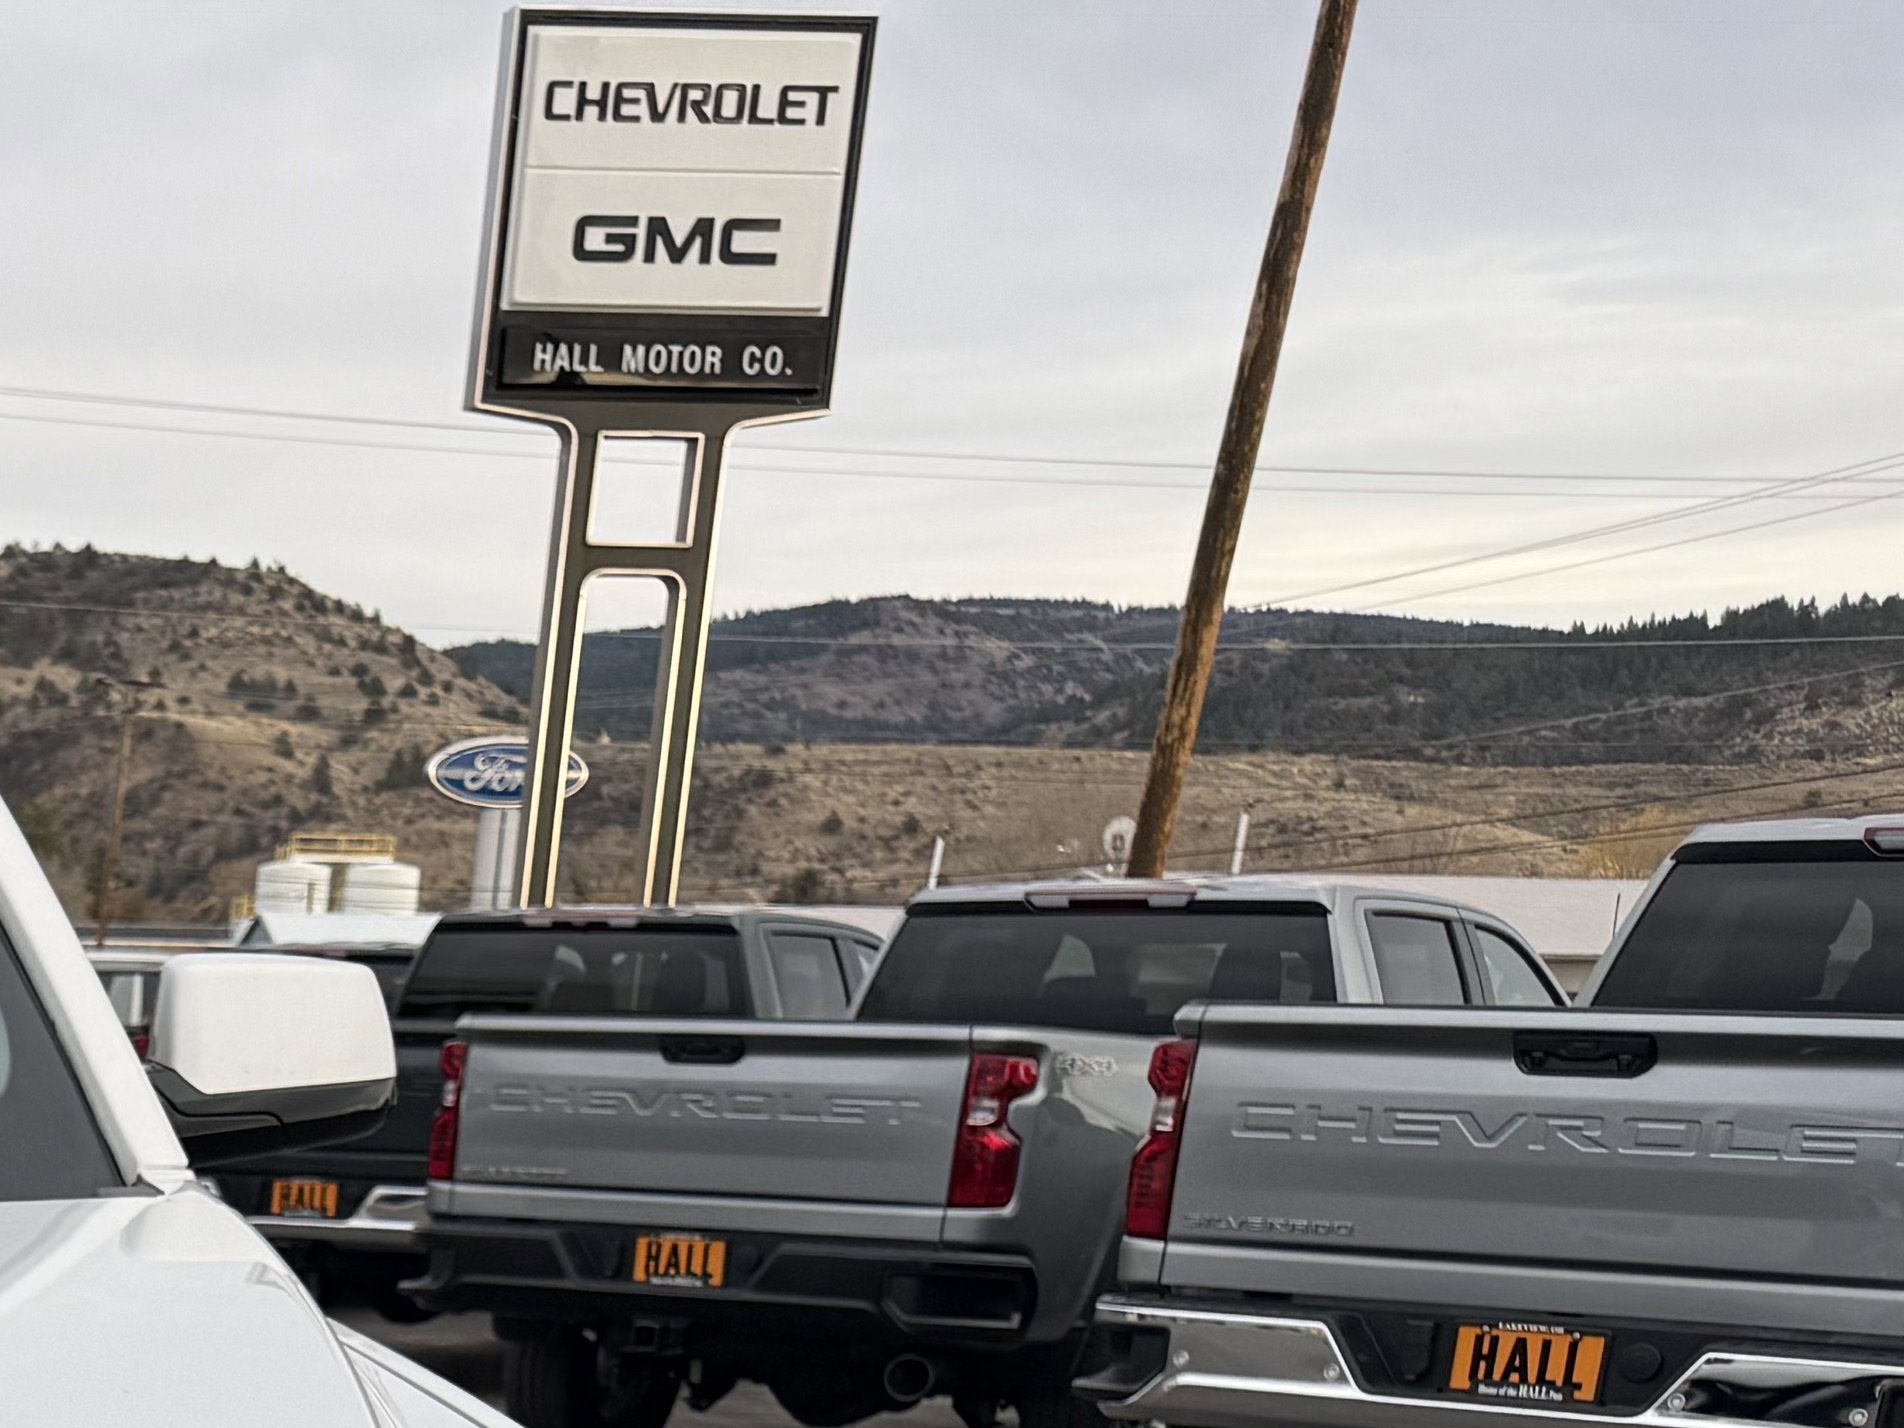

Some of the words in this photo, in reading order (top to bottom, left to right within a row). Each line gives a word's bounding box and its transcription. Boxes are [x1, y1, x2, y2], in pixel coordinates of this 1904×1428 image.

[544, 80, 840, 127] CHEVROLET
[572, 214, 782, 266] GMC
[533, 342, 603, 374] HALL
[621, 343, 723, 375] MOTOR
[742, 344, 793, 376] CO.
[464, 752, 527, 792] For
[490, 1086, 923, 1125] CHEVROLET
[1468, 1333, 1583, 1391] HALL
